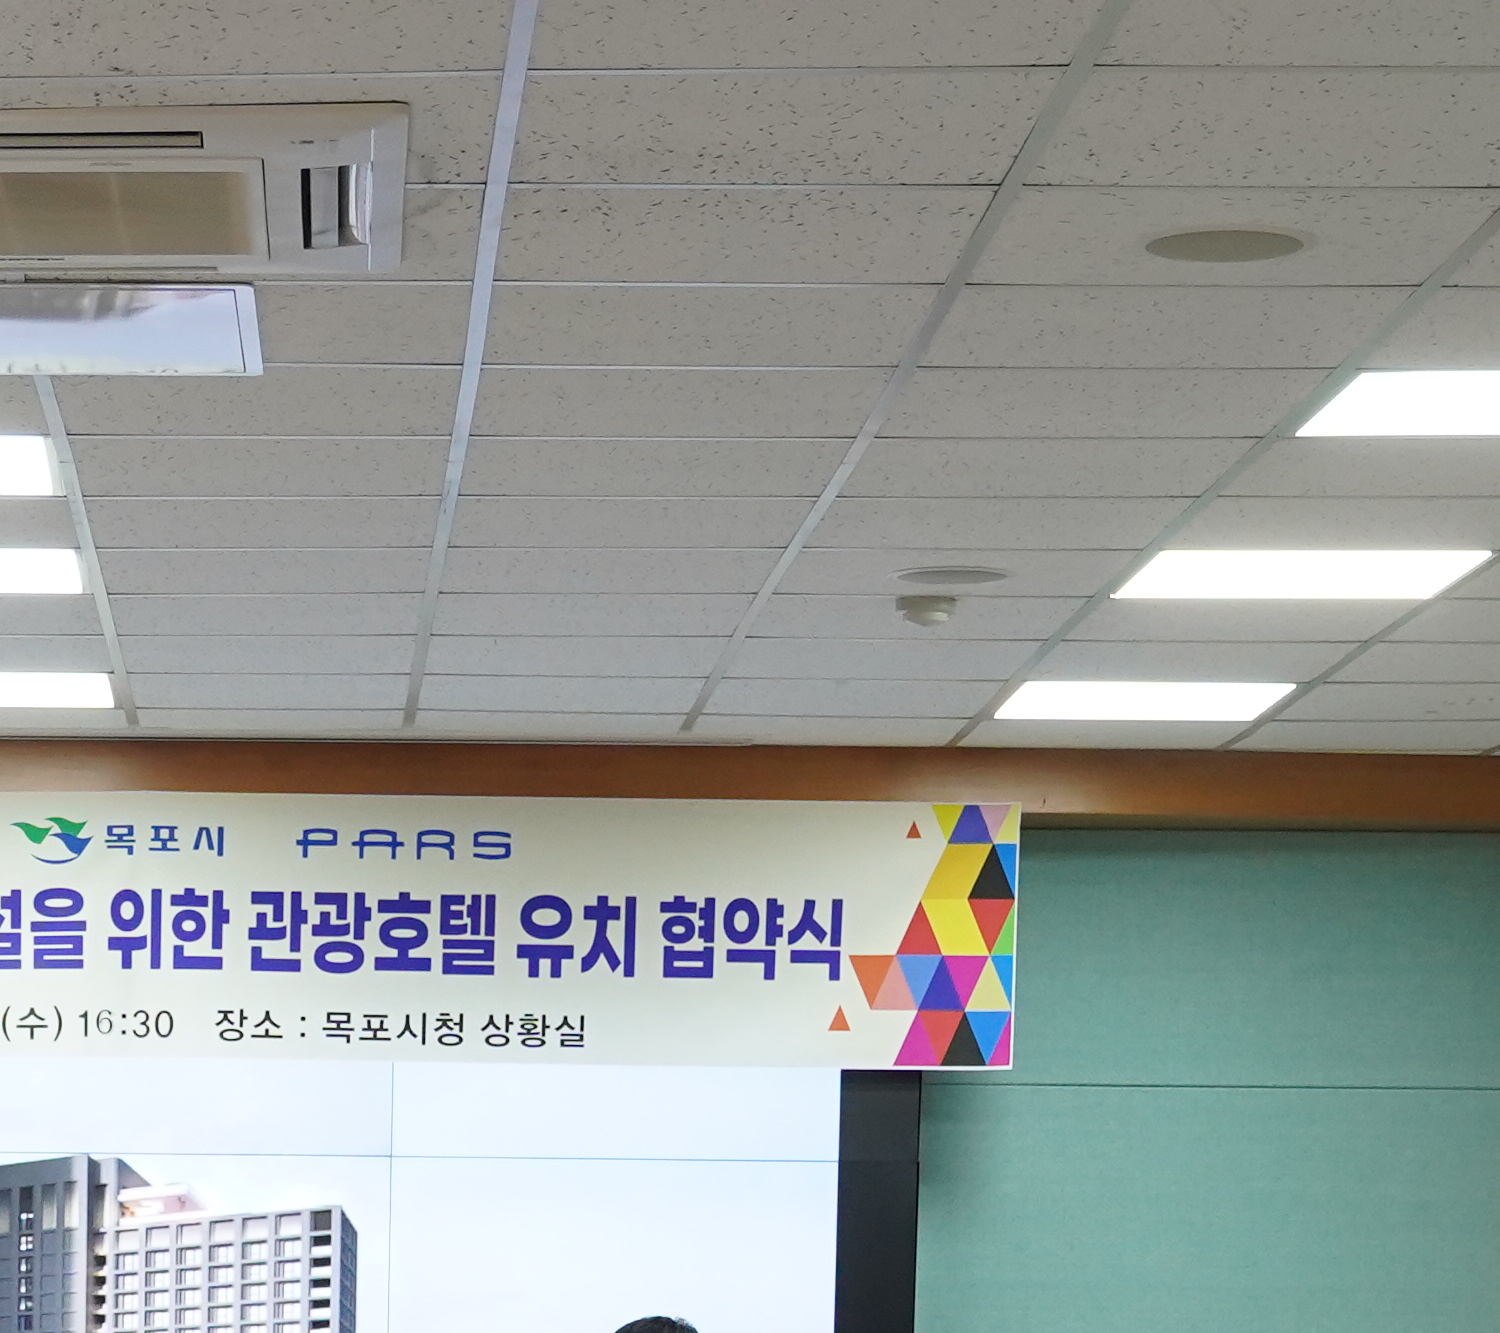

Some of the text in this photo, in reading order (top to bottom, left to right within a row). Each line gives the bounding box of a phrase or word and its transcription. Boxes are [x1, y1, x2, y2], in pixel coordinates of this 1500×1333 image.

[104, 824, 225, 857] 목포시
[295, 827, 512, 861] PARS
[107, 887, 231, 971] 위한
[247, 890, 497, 976] 관광호텔
[516, 894, 638, 979] 유치
[659, 895, 844, 982] 협약식
[78, 1010, 174, 1041] 16:30
[214, 1009, 284, 1042] 장소
[321, 1011, 464, 1047] 목포시청
[480, 1013, 585, 1049] 상황실
